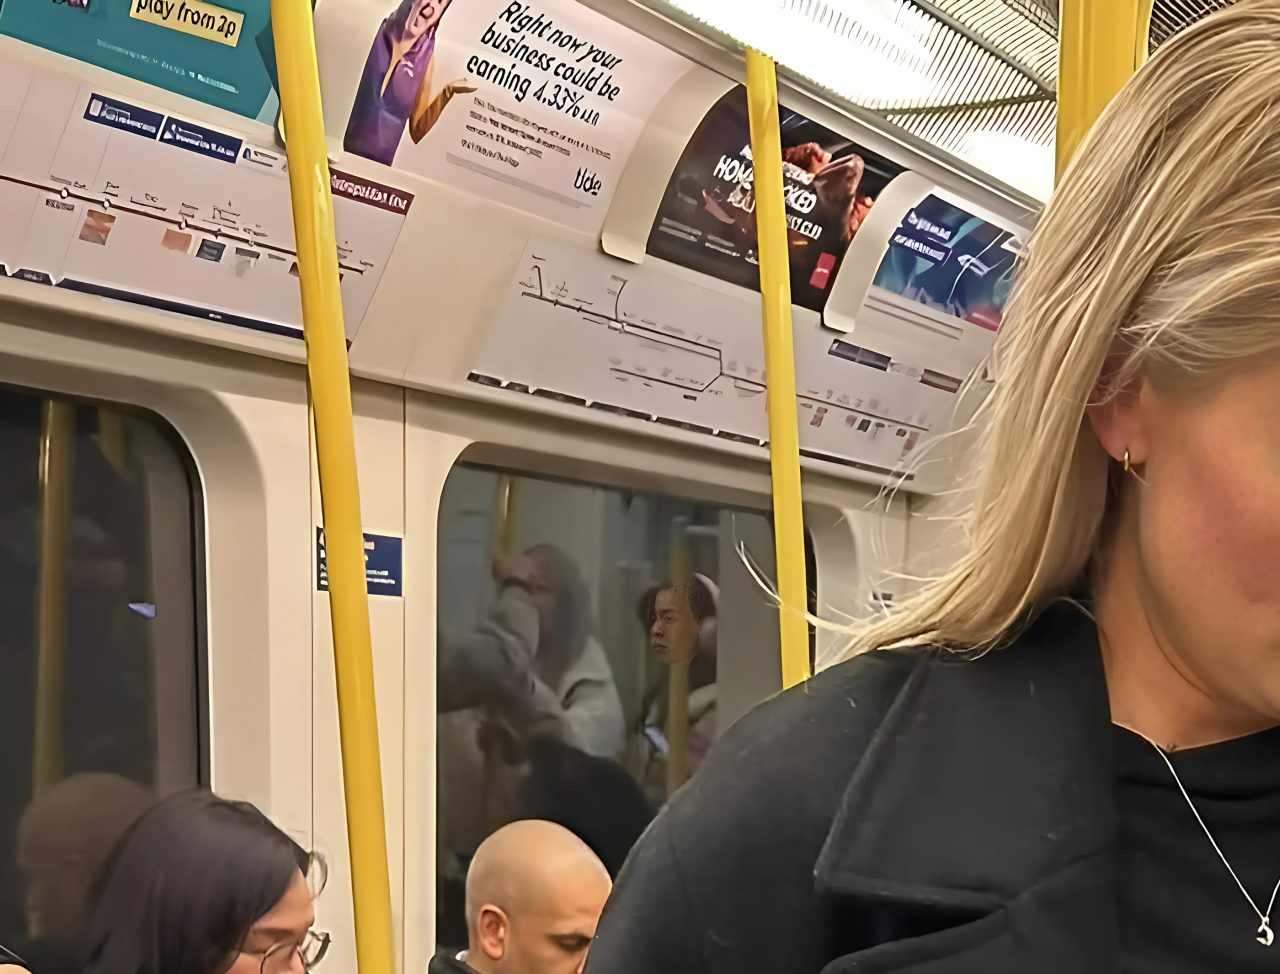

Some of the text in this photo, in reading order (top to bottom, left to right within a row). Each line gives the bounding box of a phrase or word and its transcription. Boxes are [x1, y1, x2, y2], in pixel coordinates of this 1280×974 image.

[136, 0, 236, 39] play from 2p
[498, 0, 623, 70] Right now your
[466, 55, 532, 102] earning
[480, 21, 621, 101] business could be
